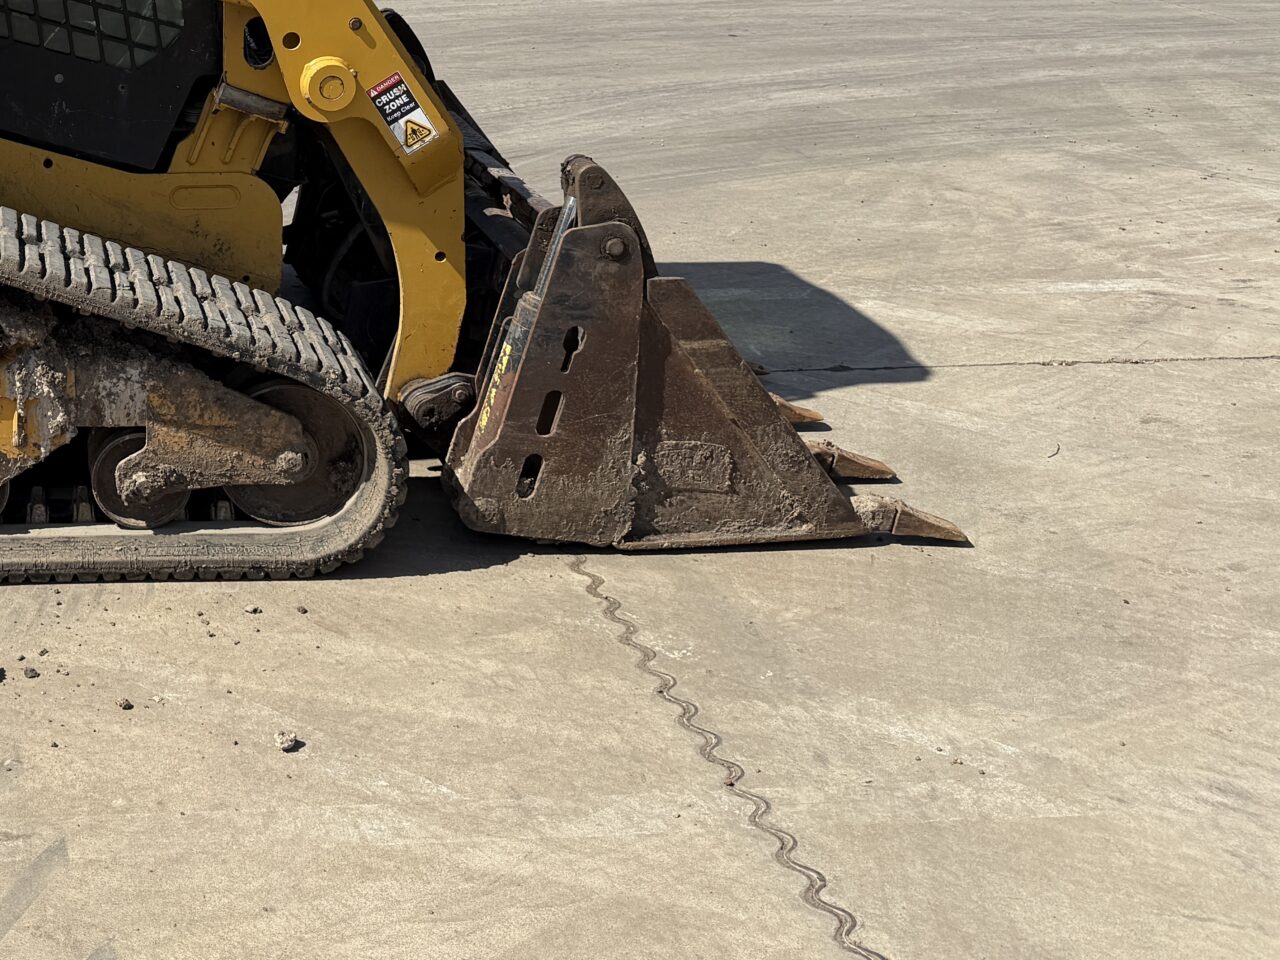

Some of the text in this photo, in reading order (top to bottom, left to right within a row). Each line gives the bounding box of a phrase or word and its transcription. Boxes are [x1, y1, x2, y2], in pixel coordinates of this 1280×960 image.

[376, 74, 400, 91] DANGER
[375, 83, 407, 107] CRUSH
[383, 93, 410, 114] ZONE
[386, 101, 416, 122] Keep Clear
